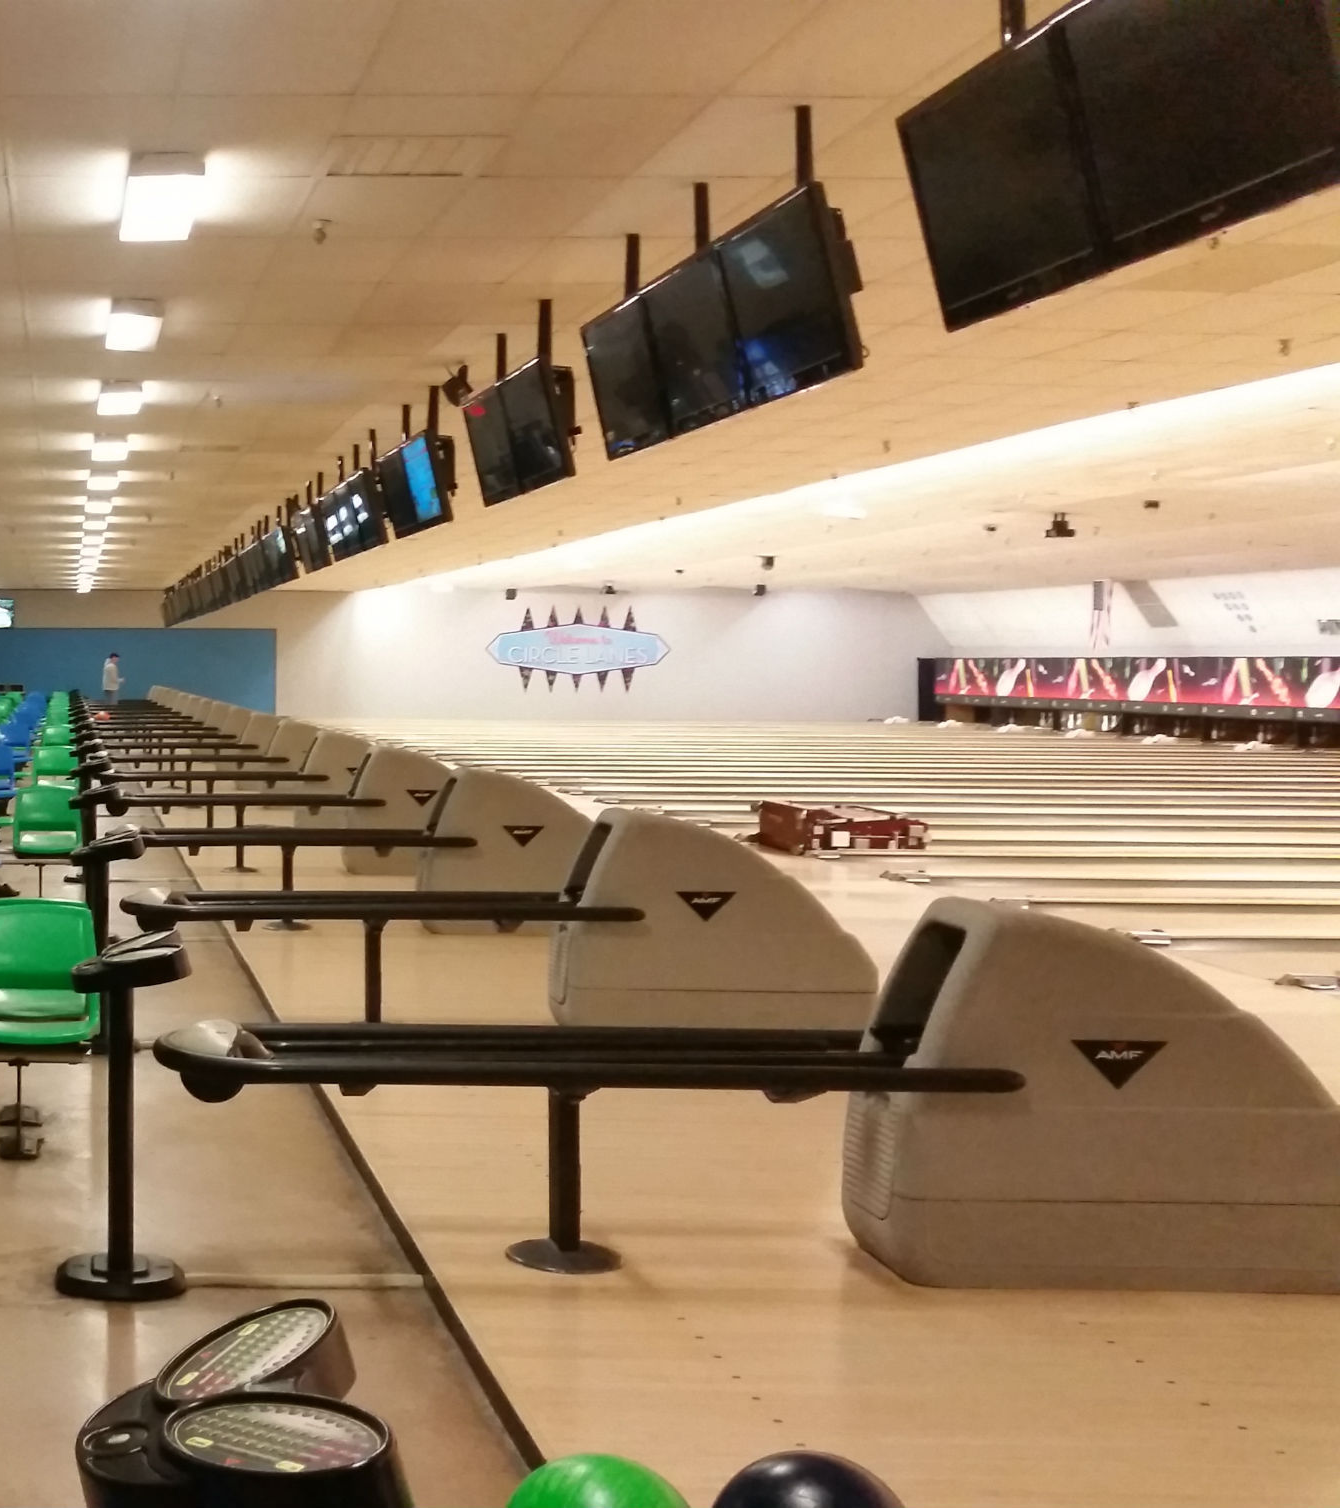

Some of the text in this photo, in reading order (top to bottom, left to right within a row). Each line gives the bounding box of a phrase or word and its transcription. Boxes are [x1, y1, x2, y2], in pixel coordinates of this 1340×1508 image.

[509, 646, 649, 664] CIRCLE LANES
[1094, 1050, 1144, 1060] AMF
